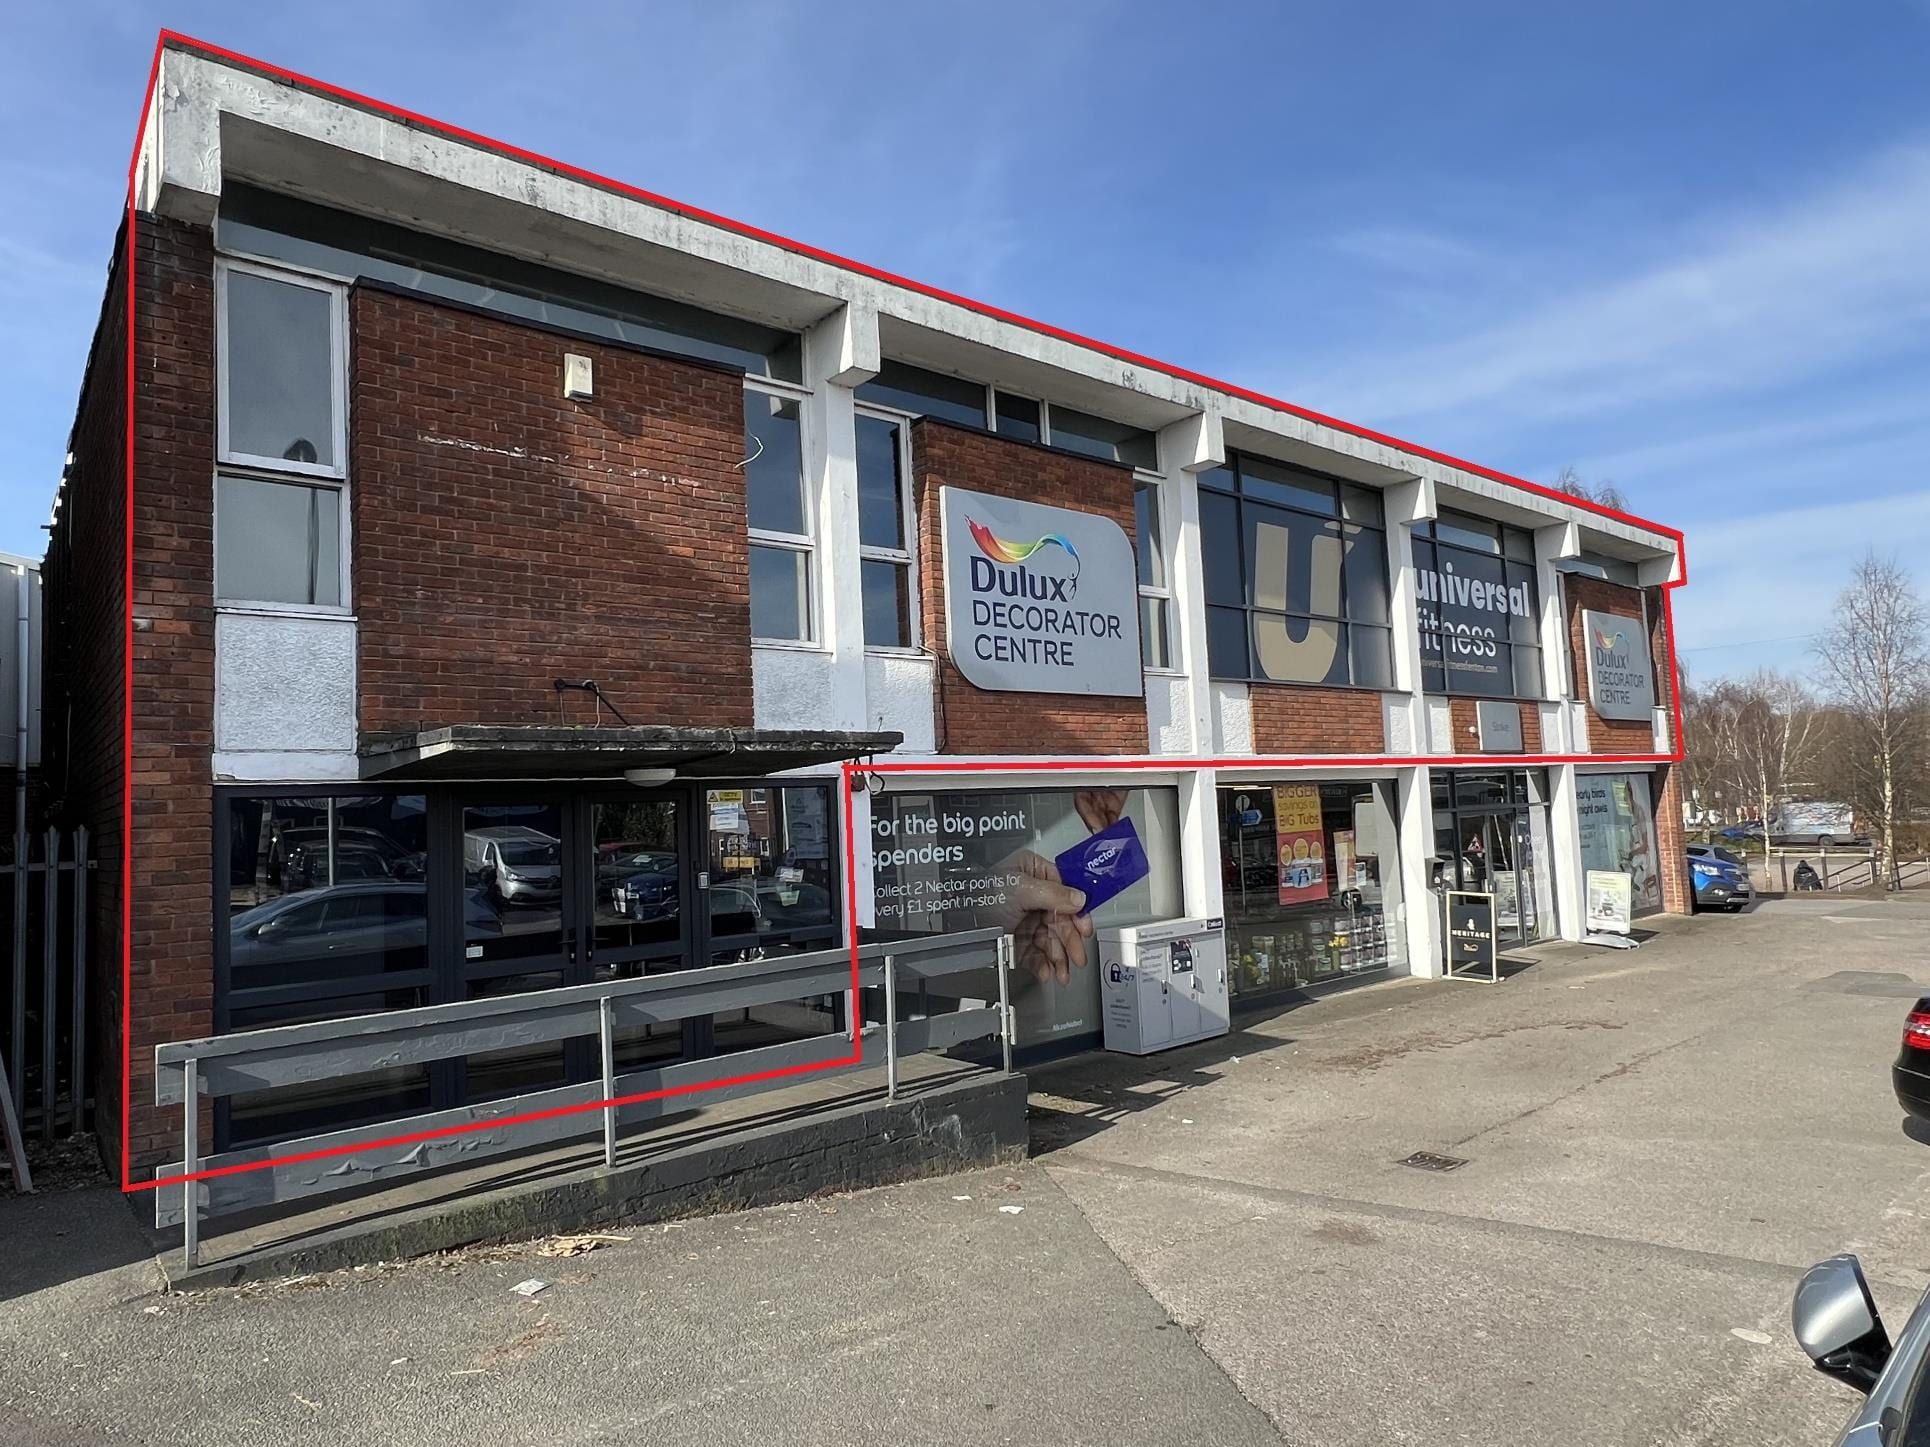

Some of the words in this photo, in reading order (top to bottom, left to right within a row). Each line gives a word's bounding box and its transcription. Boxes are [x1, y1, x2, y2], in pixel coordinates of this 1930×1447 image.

[970, 555, 1068, 603] Dulux
[1415, 561, 1530, 617] universal
[972, 599, 1122, 640] DECORATOR
[974, 633, 1075, 667] CENTRE
[1596, 646, 1627, 669] Dulux
[1598, 670, 1645, 688] DECORATOR
[1600, 688, 1631, 705] CENTRE
[905, 813, 938, 835] the
[943, 811, 974, 838] big
[979, 810, 1026, 837] point
[1279, 815, 1295, 827] BIG
[1298, 813, 1320, 826] Tubs
[1087, 846, 1117, 870] nectar
[874, 881, 912, 899] ollect
[914, 881, 923, 895] 2
[926, 879, 967, 893] Nectar
[969, 875, 1005, 891] points
[1006, 873, 1021, 887] for
[875, 902, 904, 918] very
[906, 899, 922, 914] £1
[926, 896, 960, 914] spent
[963, 893, 1006, 907] in-store
